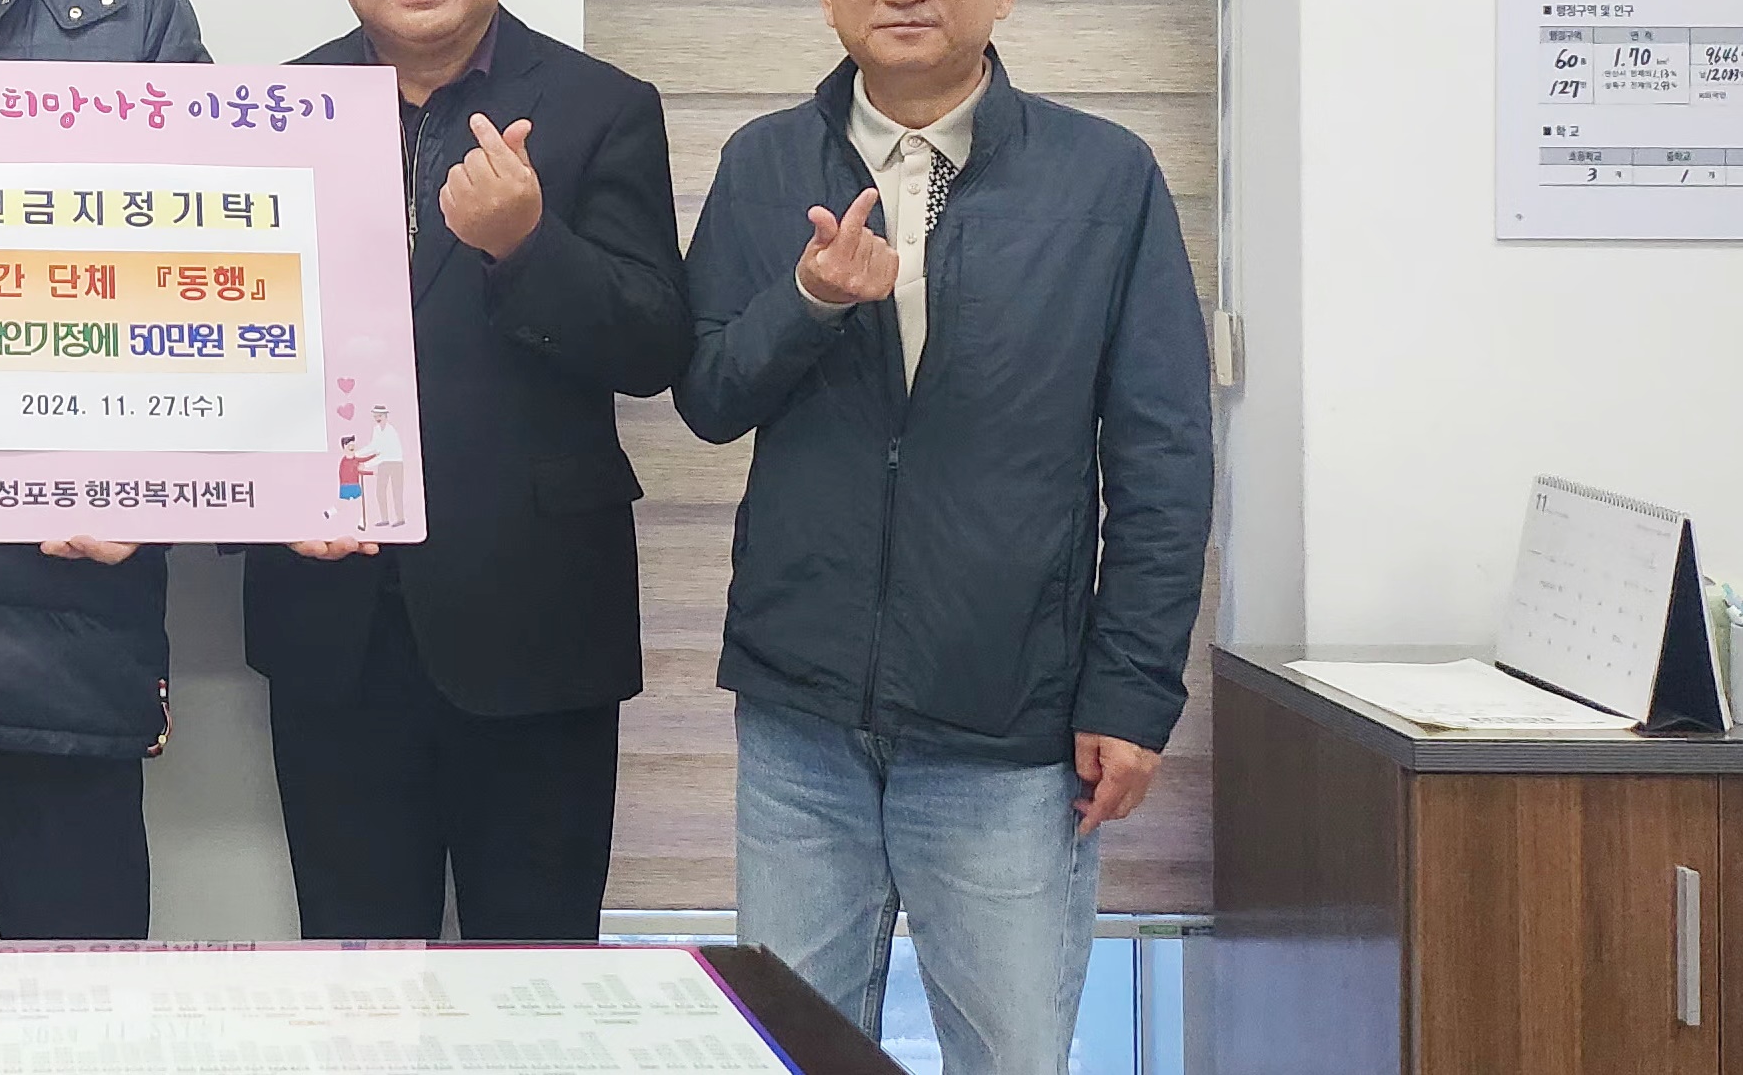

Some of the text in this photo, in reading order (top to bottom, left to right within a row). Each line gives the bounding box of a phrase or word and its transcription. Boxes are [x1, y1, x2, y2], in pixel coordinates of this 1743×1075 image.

[0, 82, 173, 129] 희망나눔
[188, 84, 335, 132] 이웃돕기
[49, 264, 116, 299] 단체
[157, 266, 266, 301] 『동행』
[130, 323, 224, 357] 50만원
[237, 323, 297, 358] 후원
[21, 394, 87, 416] 2024.
[100, 394, 136, 416] 11.
[84, 479, 255, 508] 행정복지센터
